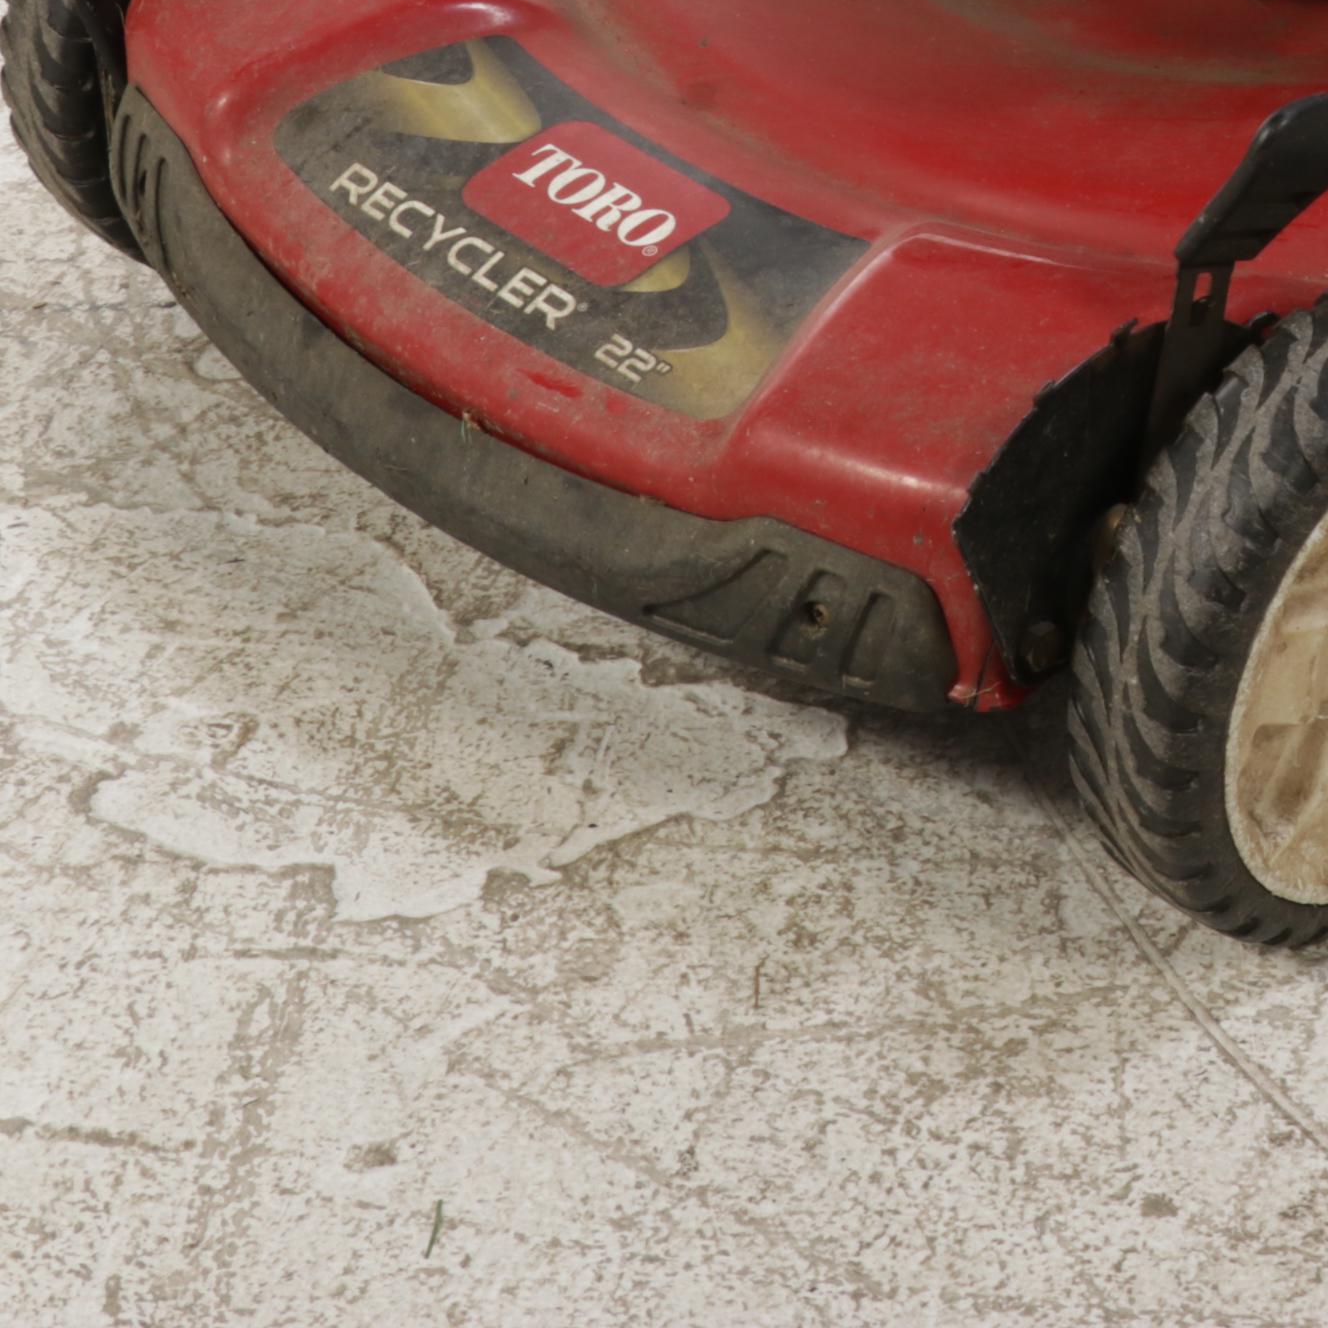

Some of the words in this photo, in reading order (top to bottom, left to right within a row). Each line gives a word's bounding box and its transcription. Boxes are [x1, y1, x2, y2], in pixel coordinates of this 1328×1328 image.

[329, 161, 578, 331] RECYCLER
[594, 332, 674, 385] 22"
[511, 142, 677, 250] TORO
